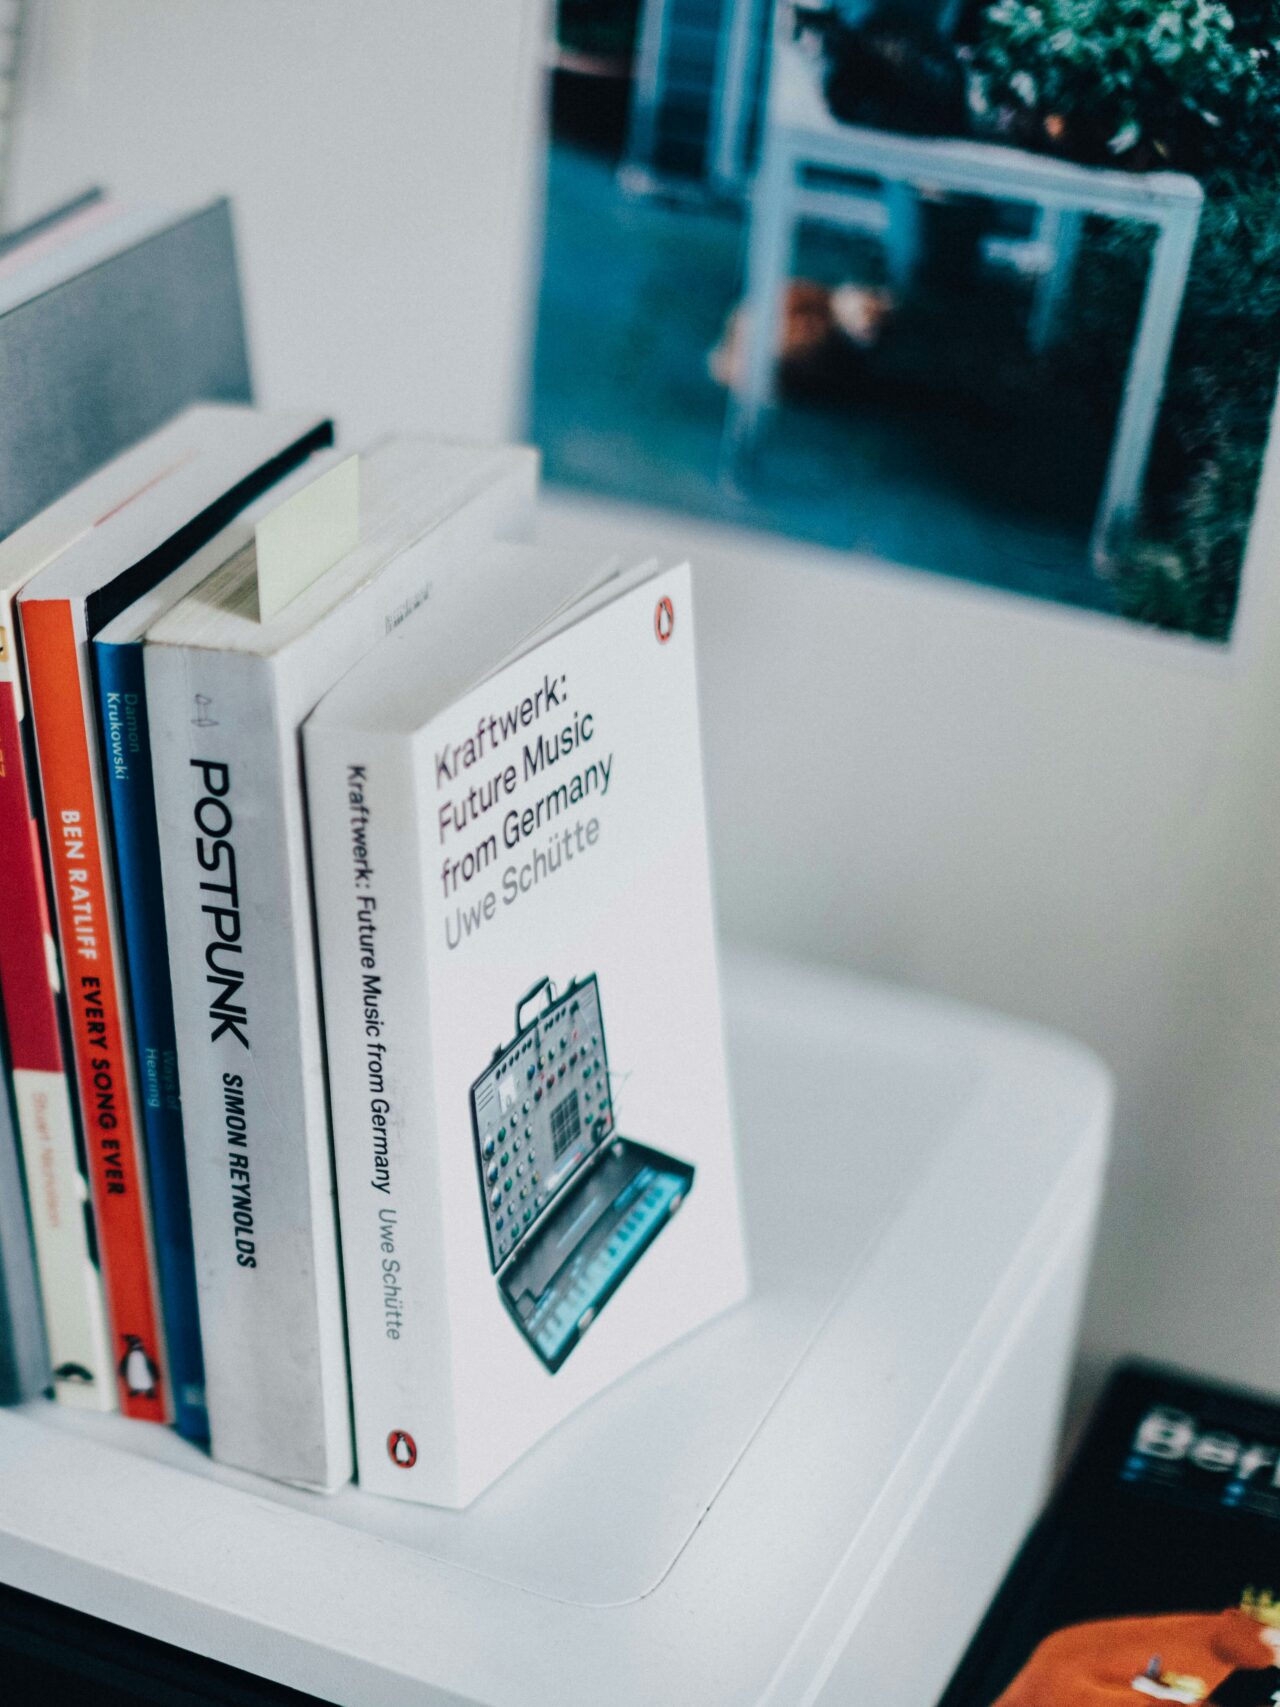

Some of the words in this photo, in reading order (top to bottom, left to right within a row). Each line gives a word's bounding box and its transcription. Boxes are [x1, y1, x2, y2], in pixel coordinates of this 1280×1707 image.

[106, 692, 130, 780] Krukowski
[123, 693, 140, 753] Damon
[433, 673, 569, 791] Kraftwerk:
[437, 764, 517, 846] Future
[522, 710, 595, 783] Music
[60, 809, 86, 860] BEN
[346, 763, 374, 889] Kraftwerk:
[439, 833, 498, 899] from
[501, 752, 615, 851] Germany
[67, 868, 99, 961] RATLIFF
[189, 757, 251, 1051] POSTPUNK
[444, 890, 497, 952] Uwe
[501, 815, 601, 906] Schütte
[355, 895, 377, 970] Future
[80, 976, 110, 1051] EVERY
[361, 974, 386, 1038] Music
[91, 1057, 118, 1131] SONG
[144, 1047, 161, 1108] Hearing
[366, 1040, 387, 1094] from
[222, 1072, 248, 1148] SIMON
[370, 1098, 392, 1195] Germany
[101, 1138, 127, 1196] EVER
[228, 1152, 257, 1270] REYNOLDS
[378, 1208, 397, 1255] Uwe
[381, 1256, 404, 1341] Schütte
